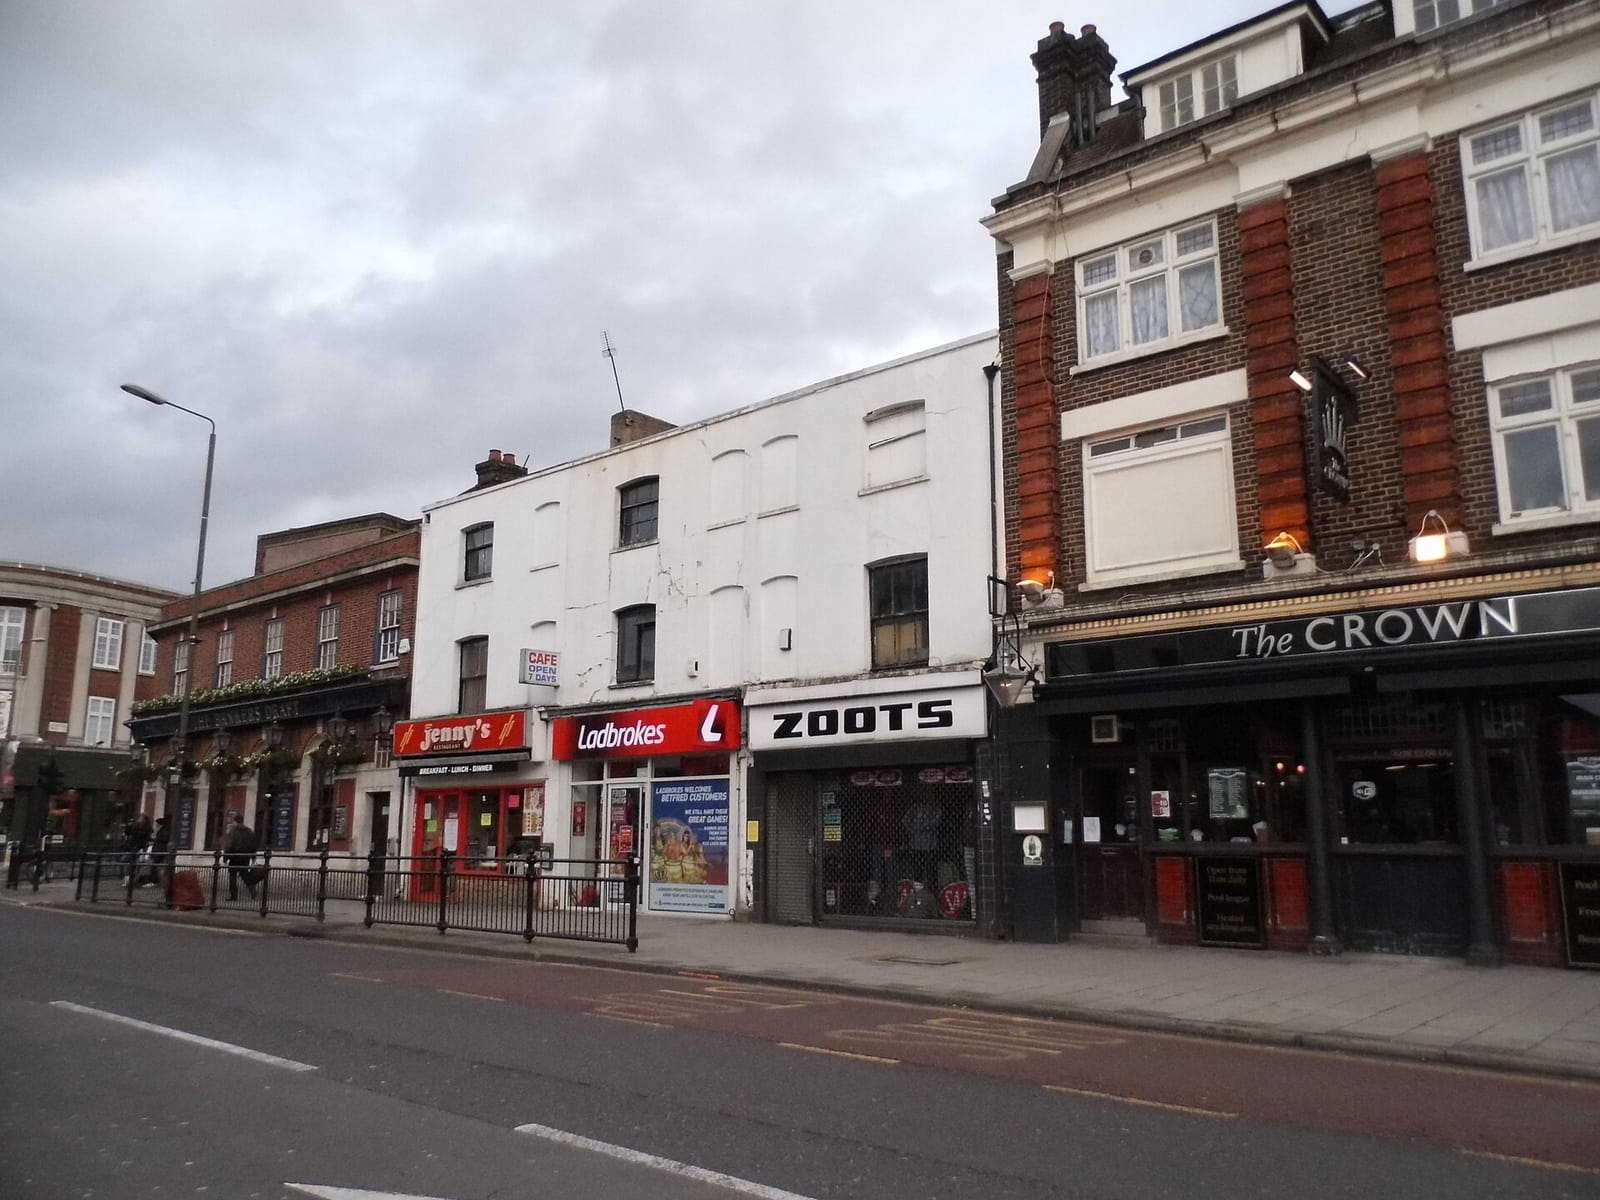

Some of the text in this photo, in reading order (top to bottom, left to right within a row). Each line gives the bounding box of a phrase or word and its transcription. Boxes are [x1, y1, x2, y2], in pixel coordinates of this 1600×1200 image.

[1232, 598, 1519, 658] The CROWN
[529, 652, 557, 666] CAFE
[528, 665, 557, 674] OPEN
[535, 674, 557, 683] DAYS
[773, 699, 953, 739] ZOOTS
[577, 719, 667, 750] Ladbrokes
[419, 764, 493, 775] BREAKFAST LUNCH DINNER
[655, 785, 712, 794] LADBROKES WELCOMES
[661, 792, 727, 802] BETFRED CUSTOMERS
[688, 815, 728, 824] GREAT GAMES!
